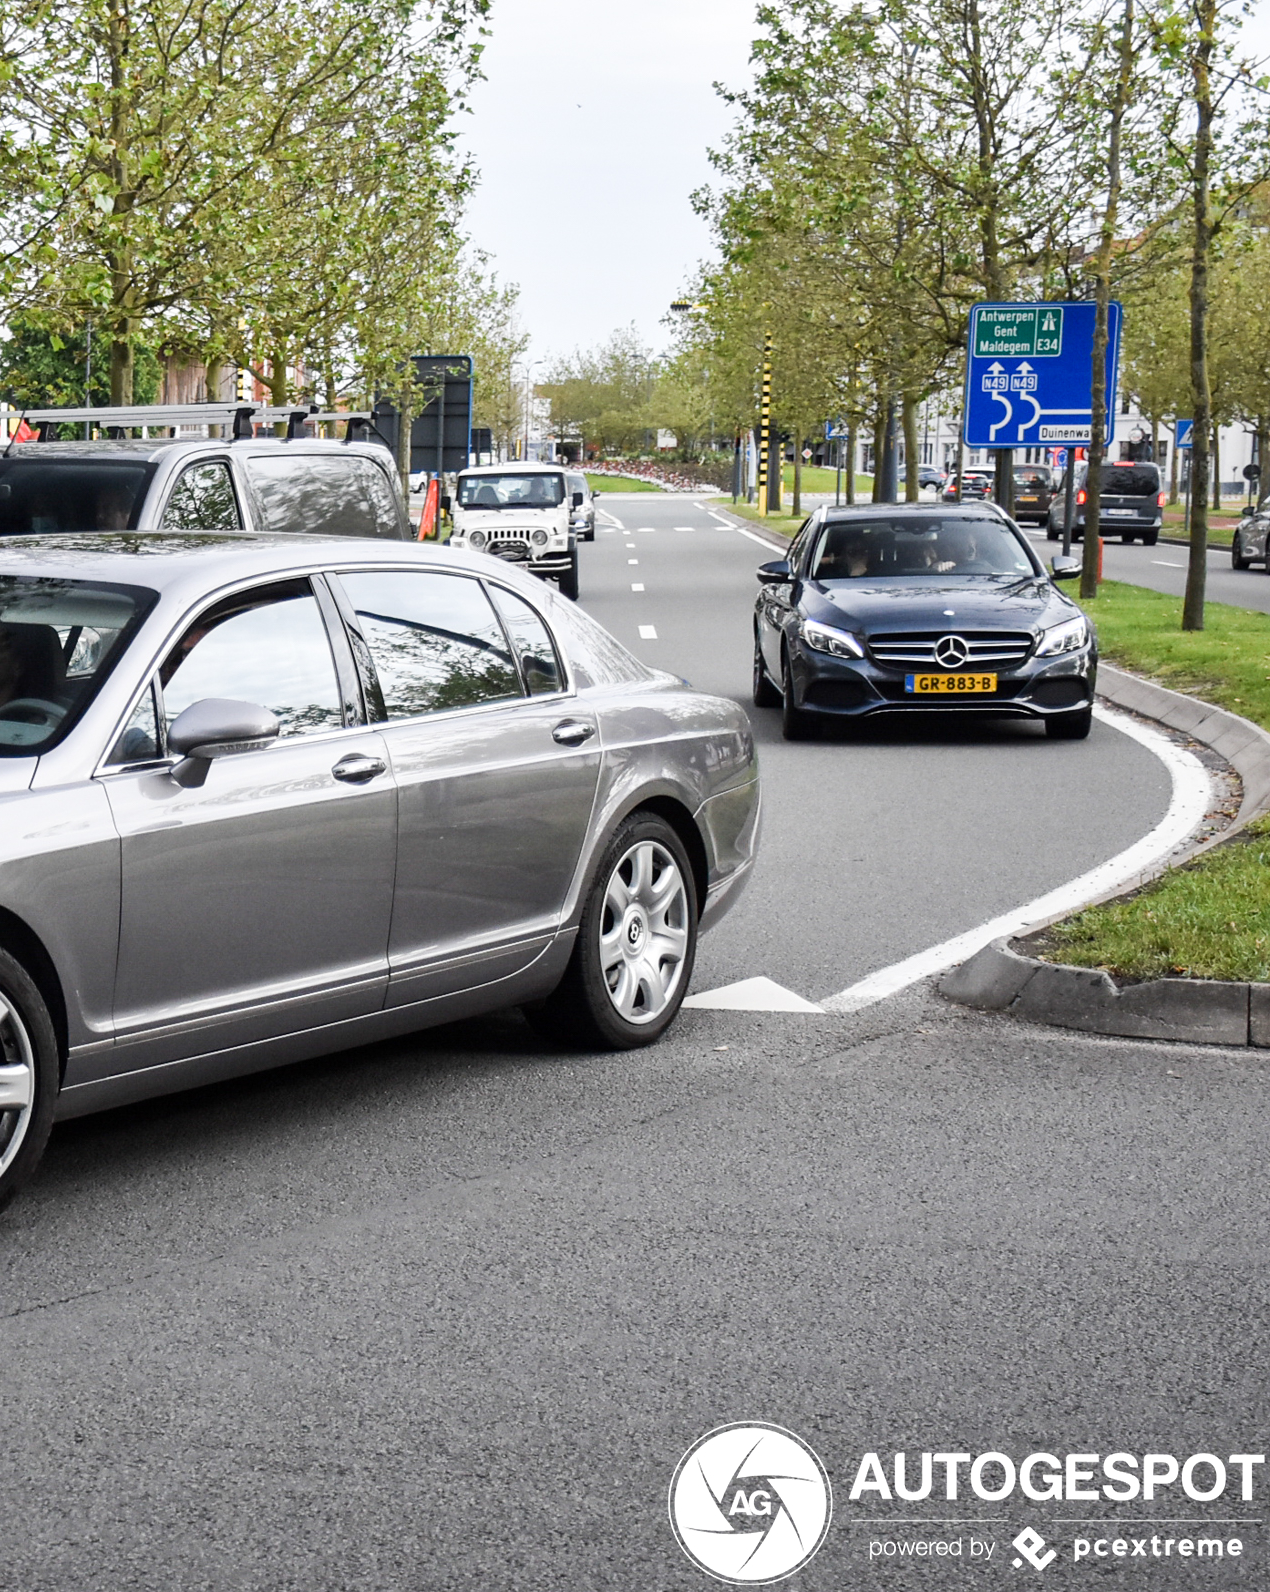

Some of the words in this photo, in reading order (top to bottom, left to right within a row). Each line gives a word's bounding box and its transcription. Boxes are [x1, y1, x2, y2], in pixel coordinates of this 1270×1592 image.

[980, 310, 1034, 324] Antwerpen
[994, 326, 1017, 337] Gent
[980, 341, 1030, 354] Maldegem
[1037, 338, 1058, 351] E34
[984, 377, 1006, 389] N49
[1013, 377, 1035, 389] N49
[1041, 427, 1090, 439] Duinenwa
[919, 677, 991, 690] GR-883-B
